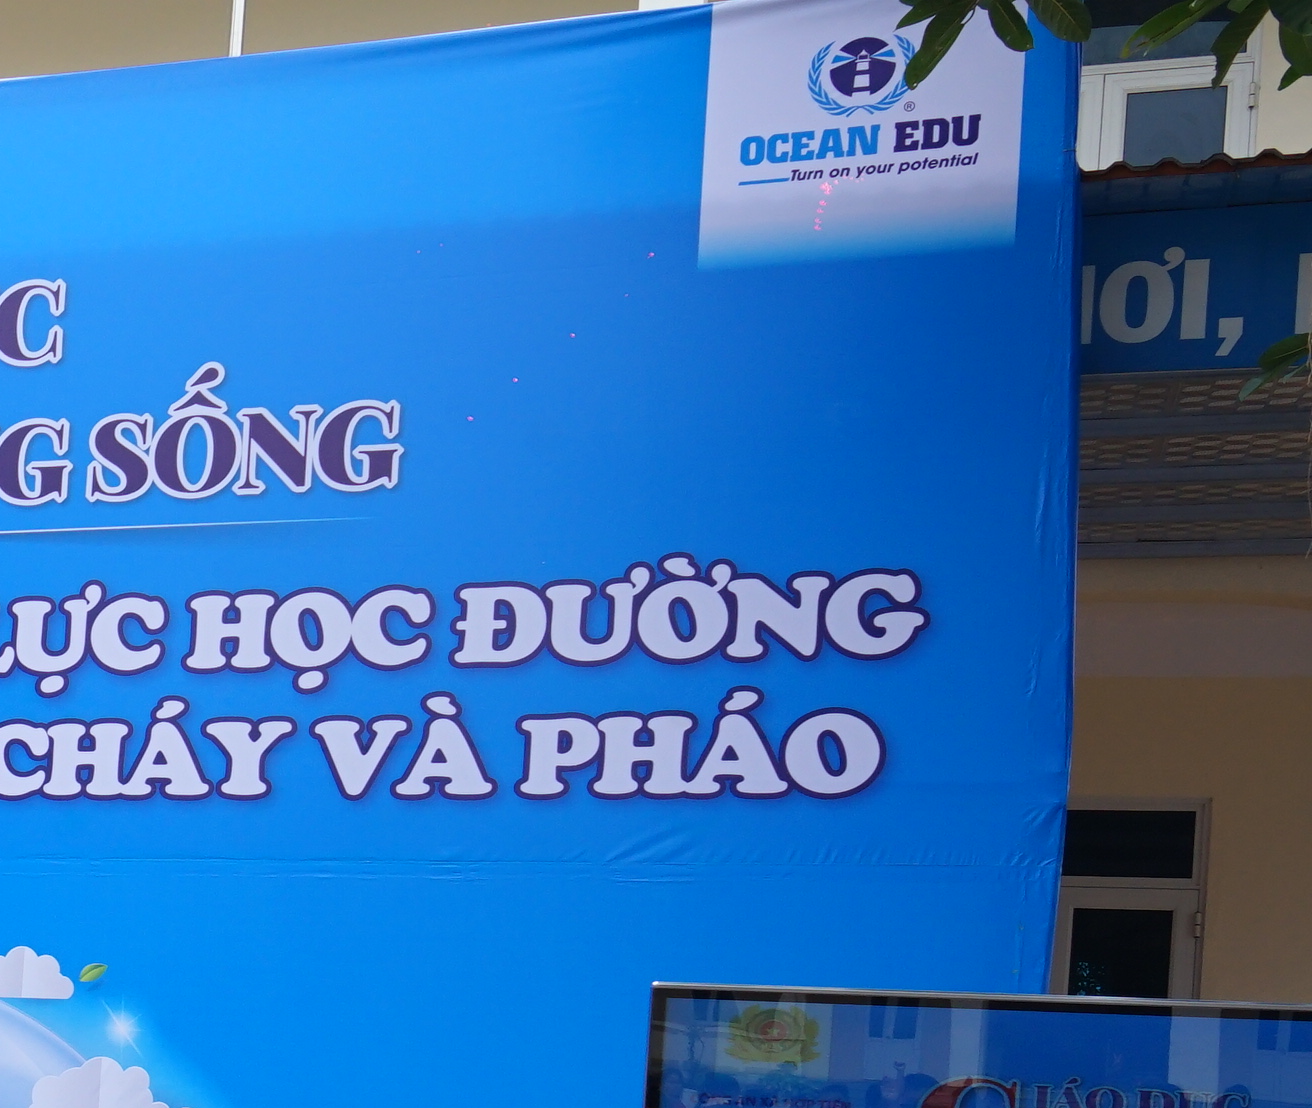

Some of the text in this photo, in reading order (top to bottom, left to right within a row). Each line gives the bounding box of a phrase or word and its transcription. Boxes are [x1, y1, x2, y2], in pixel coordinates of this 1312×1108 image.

[739, 113, 982, 167] OCEAN EDU
[790, 152, 979, 182] Turn on your potential
[85, 360, 403, 503] SỐNG
[184, 588, 436, 695] HỌC
[451, 552, 928, 668] ĐƯỜNG
[310, 692, 497, 801] VÀ
[514, 686, 887, 802] PHÁO
